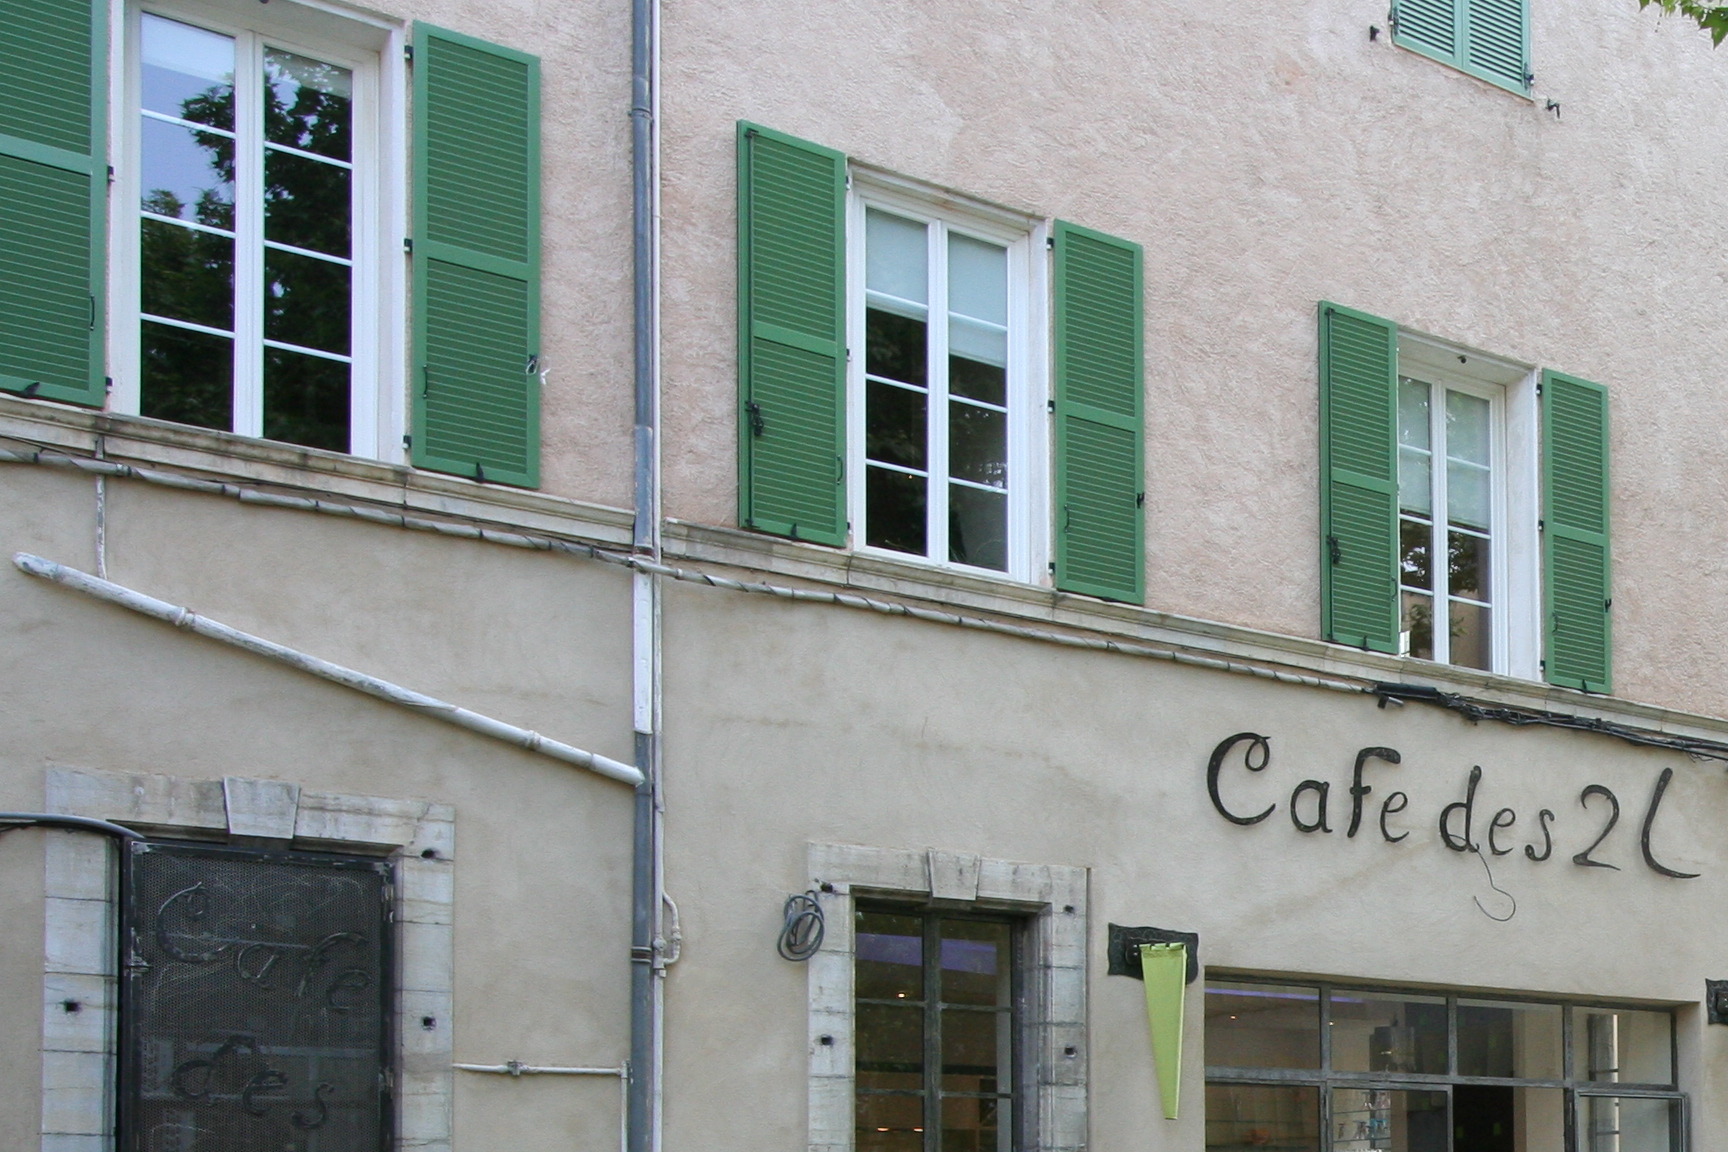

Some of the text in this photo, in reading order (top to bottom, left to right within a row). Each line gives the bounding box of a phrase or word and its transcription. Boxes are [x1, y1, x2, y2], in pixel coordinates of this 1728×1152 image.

[1206, 731, 1410, 843] Cafe
[1439, 765, 1555, 862] des
[1572, 784, 1621, 871] 2
